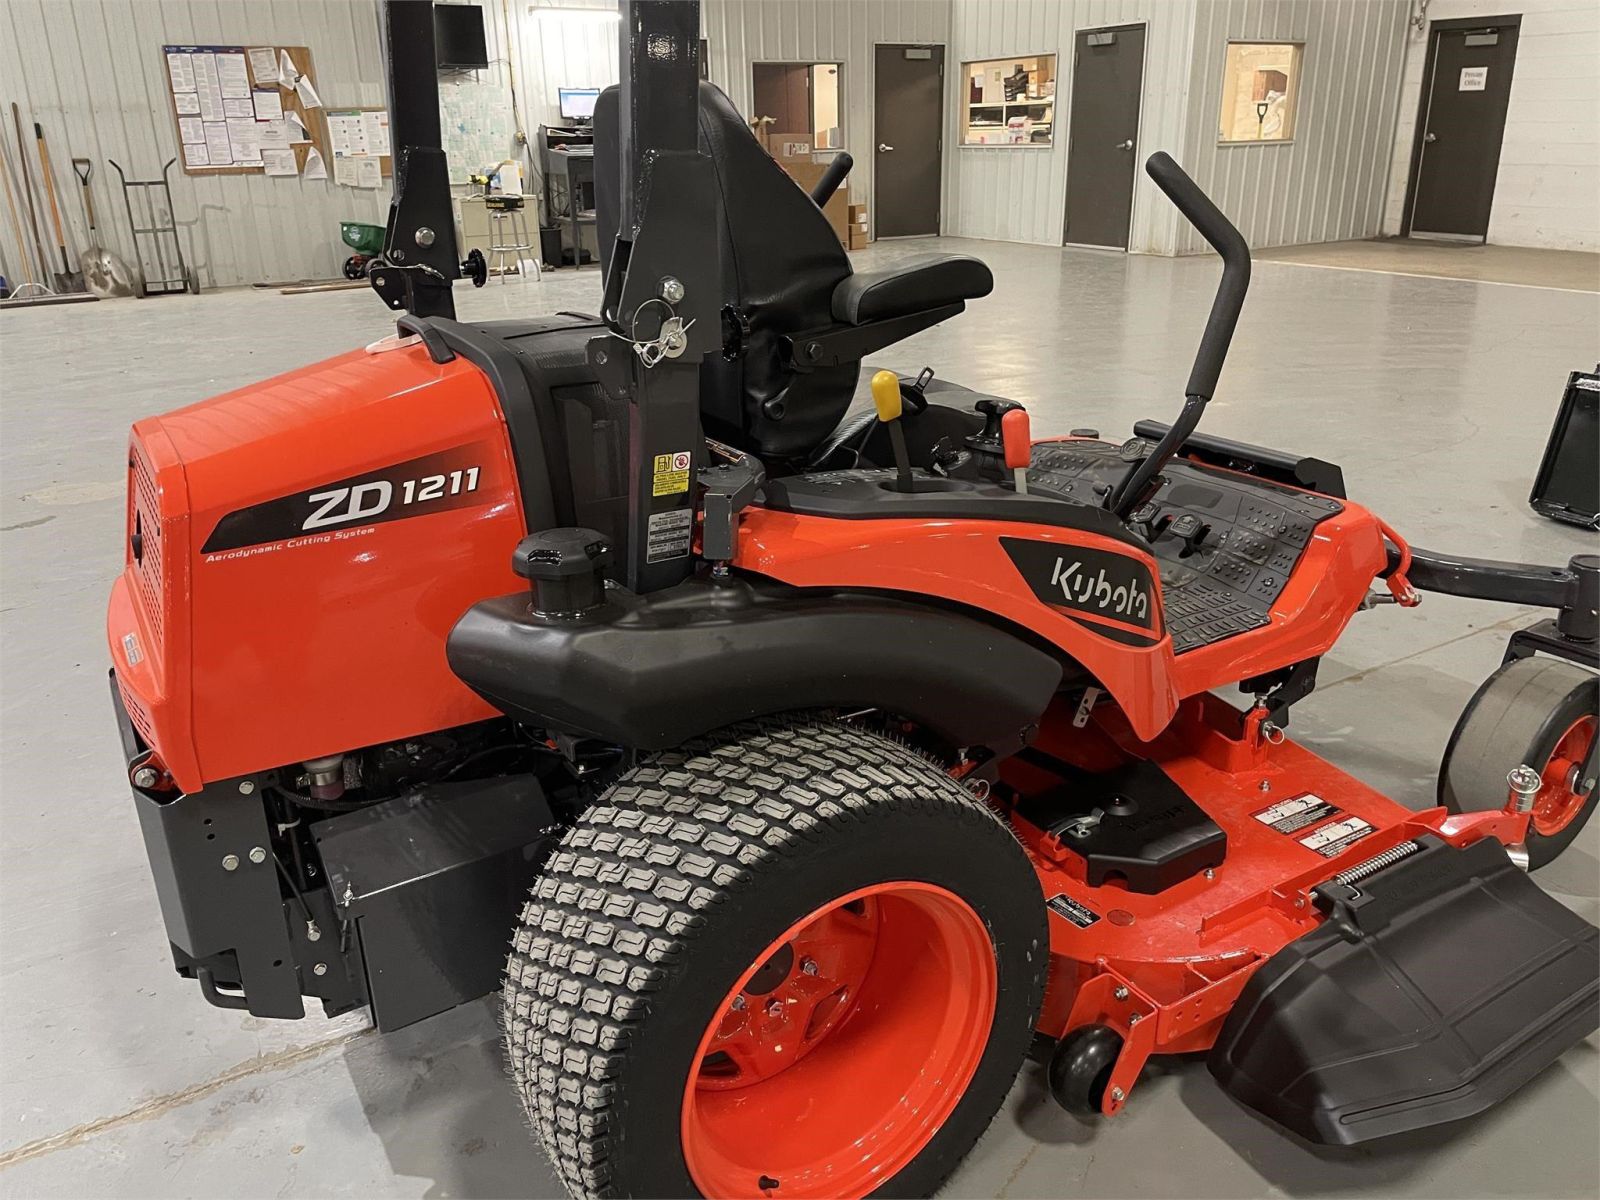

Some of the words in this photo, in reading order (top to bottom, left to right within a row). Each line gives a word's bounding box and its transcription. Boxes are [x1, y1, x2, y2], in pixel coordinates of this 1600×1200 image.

[302, 480, 392, 531] ZD
[402, 466, 480, 505] 1211
[205, 543, 282, 564] Aerodynamic
[287, 534, 331, 549] Cutting
[334, 527, 376, 541] System
[1050, 556, 1147, 619] Kubota
